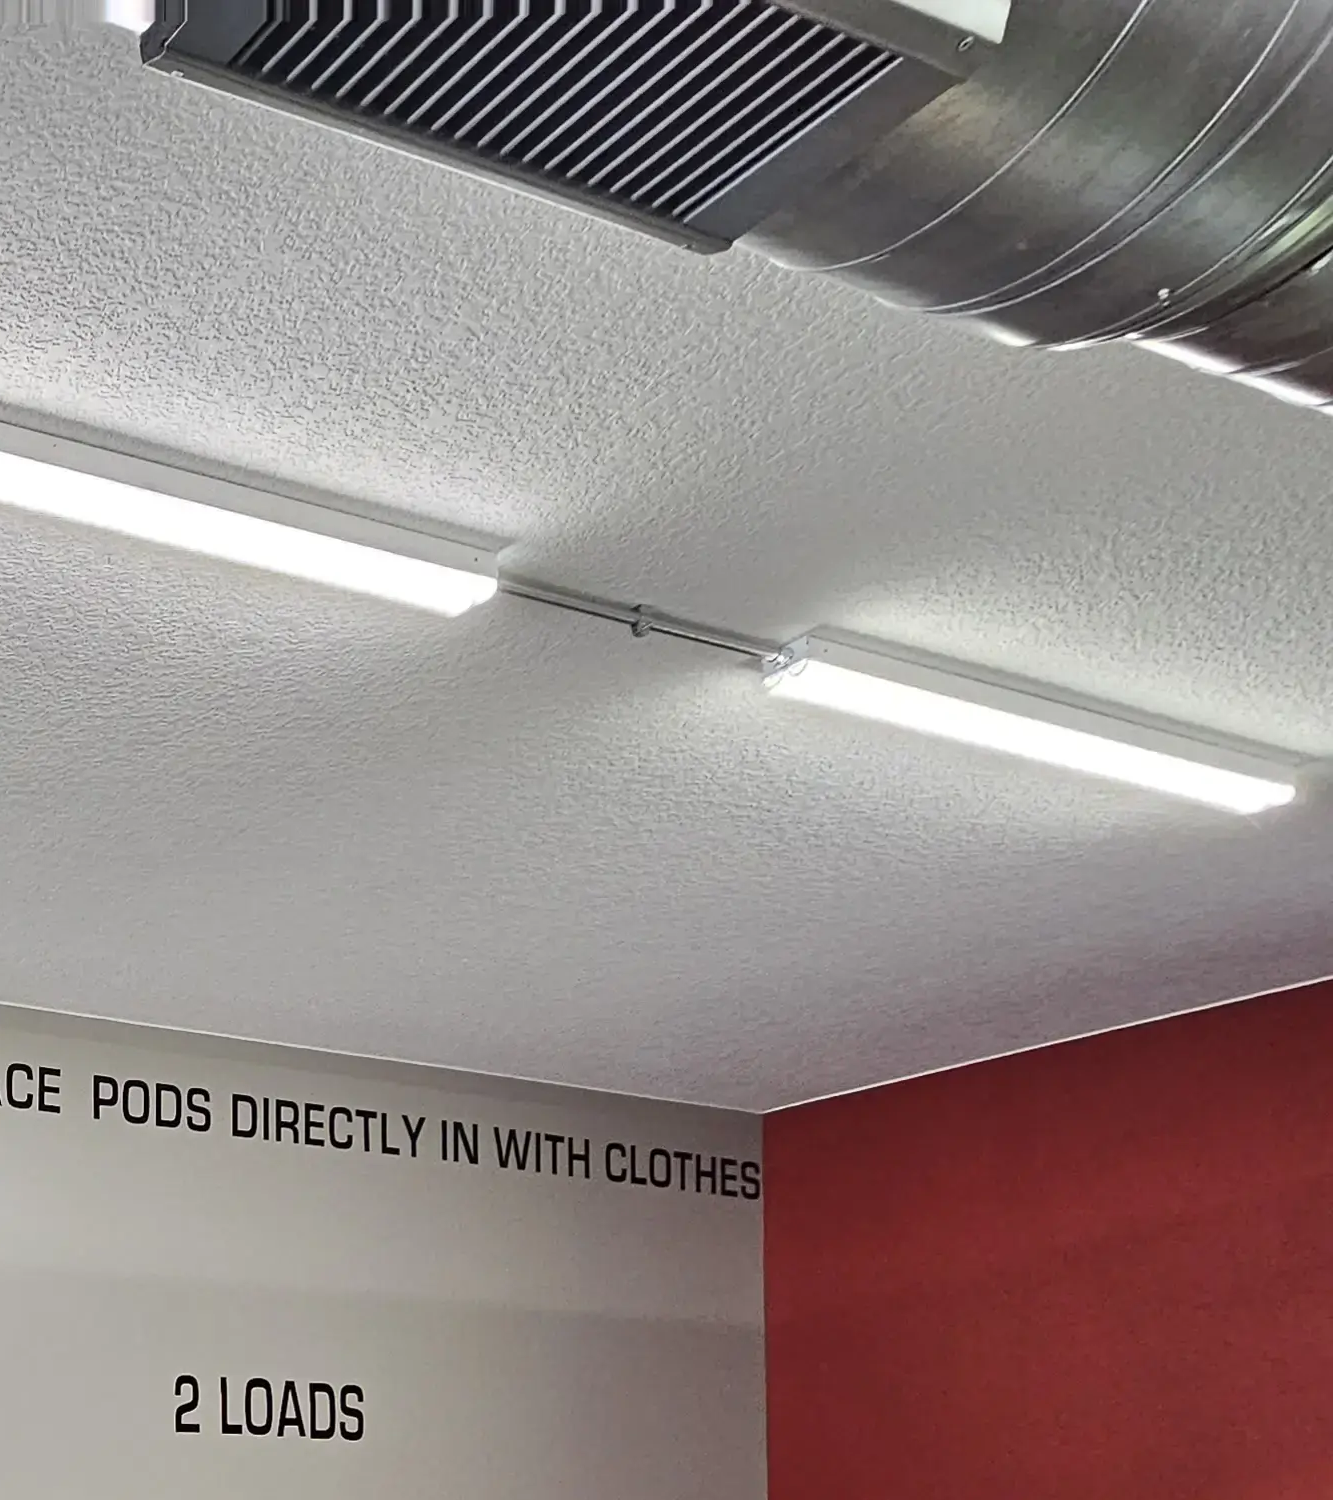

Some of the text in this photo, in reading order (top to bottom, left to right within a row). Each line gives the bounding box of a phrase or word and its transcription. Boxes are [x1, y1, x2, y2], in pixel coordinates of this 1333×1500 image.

[93, 1074, 211, 1132] PODS
[231, 1093, 427, 1158] DIRECTLY
[441, 1119, 479, 1165] IN
[493, 1126, 591, 1180] WITH
[604, 1141, 762, 1201] CLOTHES
[174, 1374, 364, 1441] 2 LOADS
